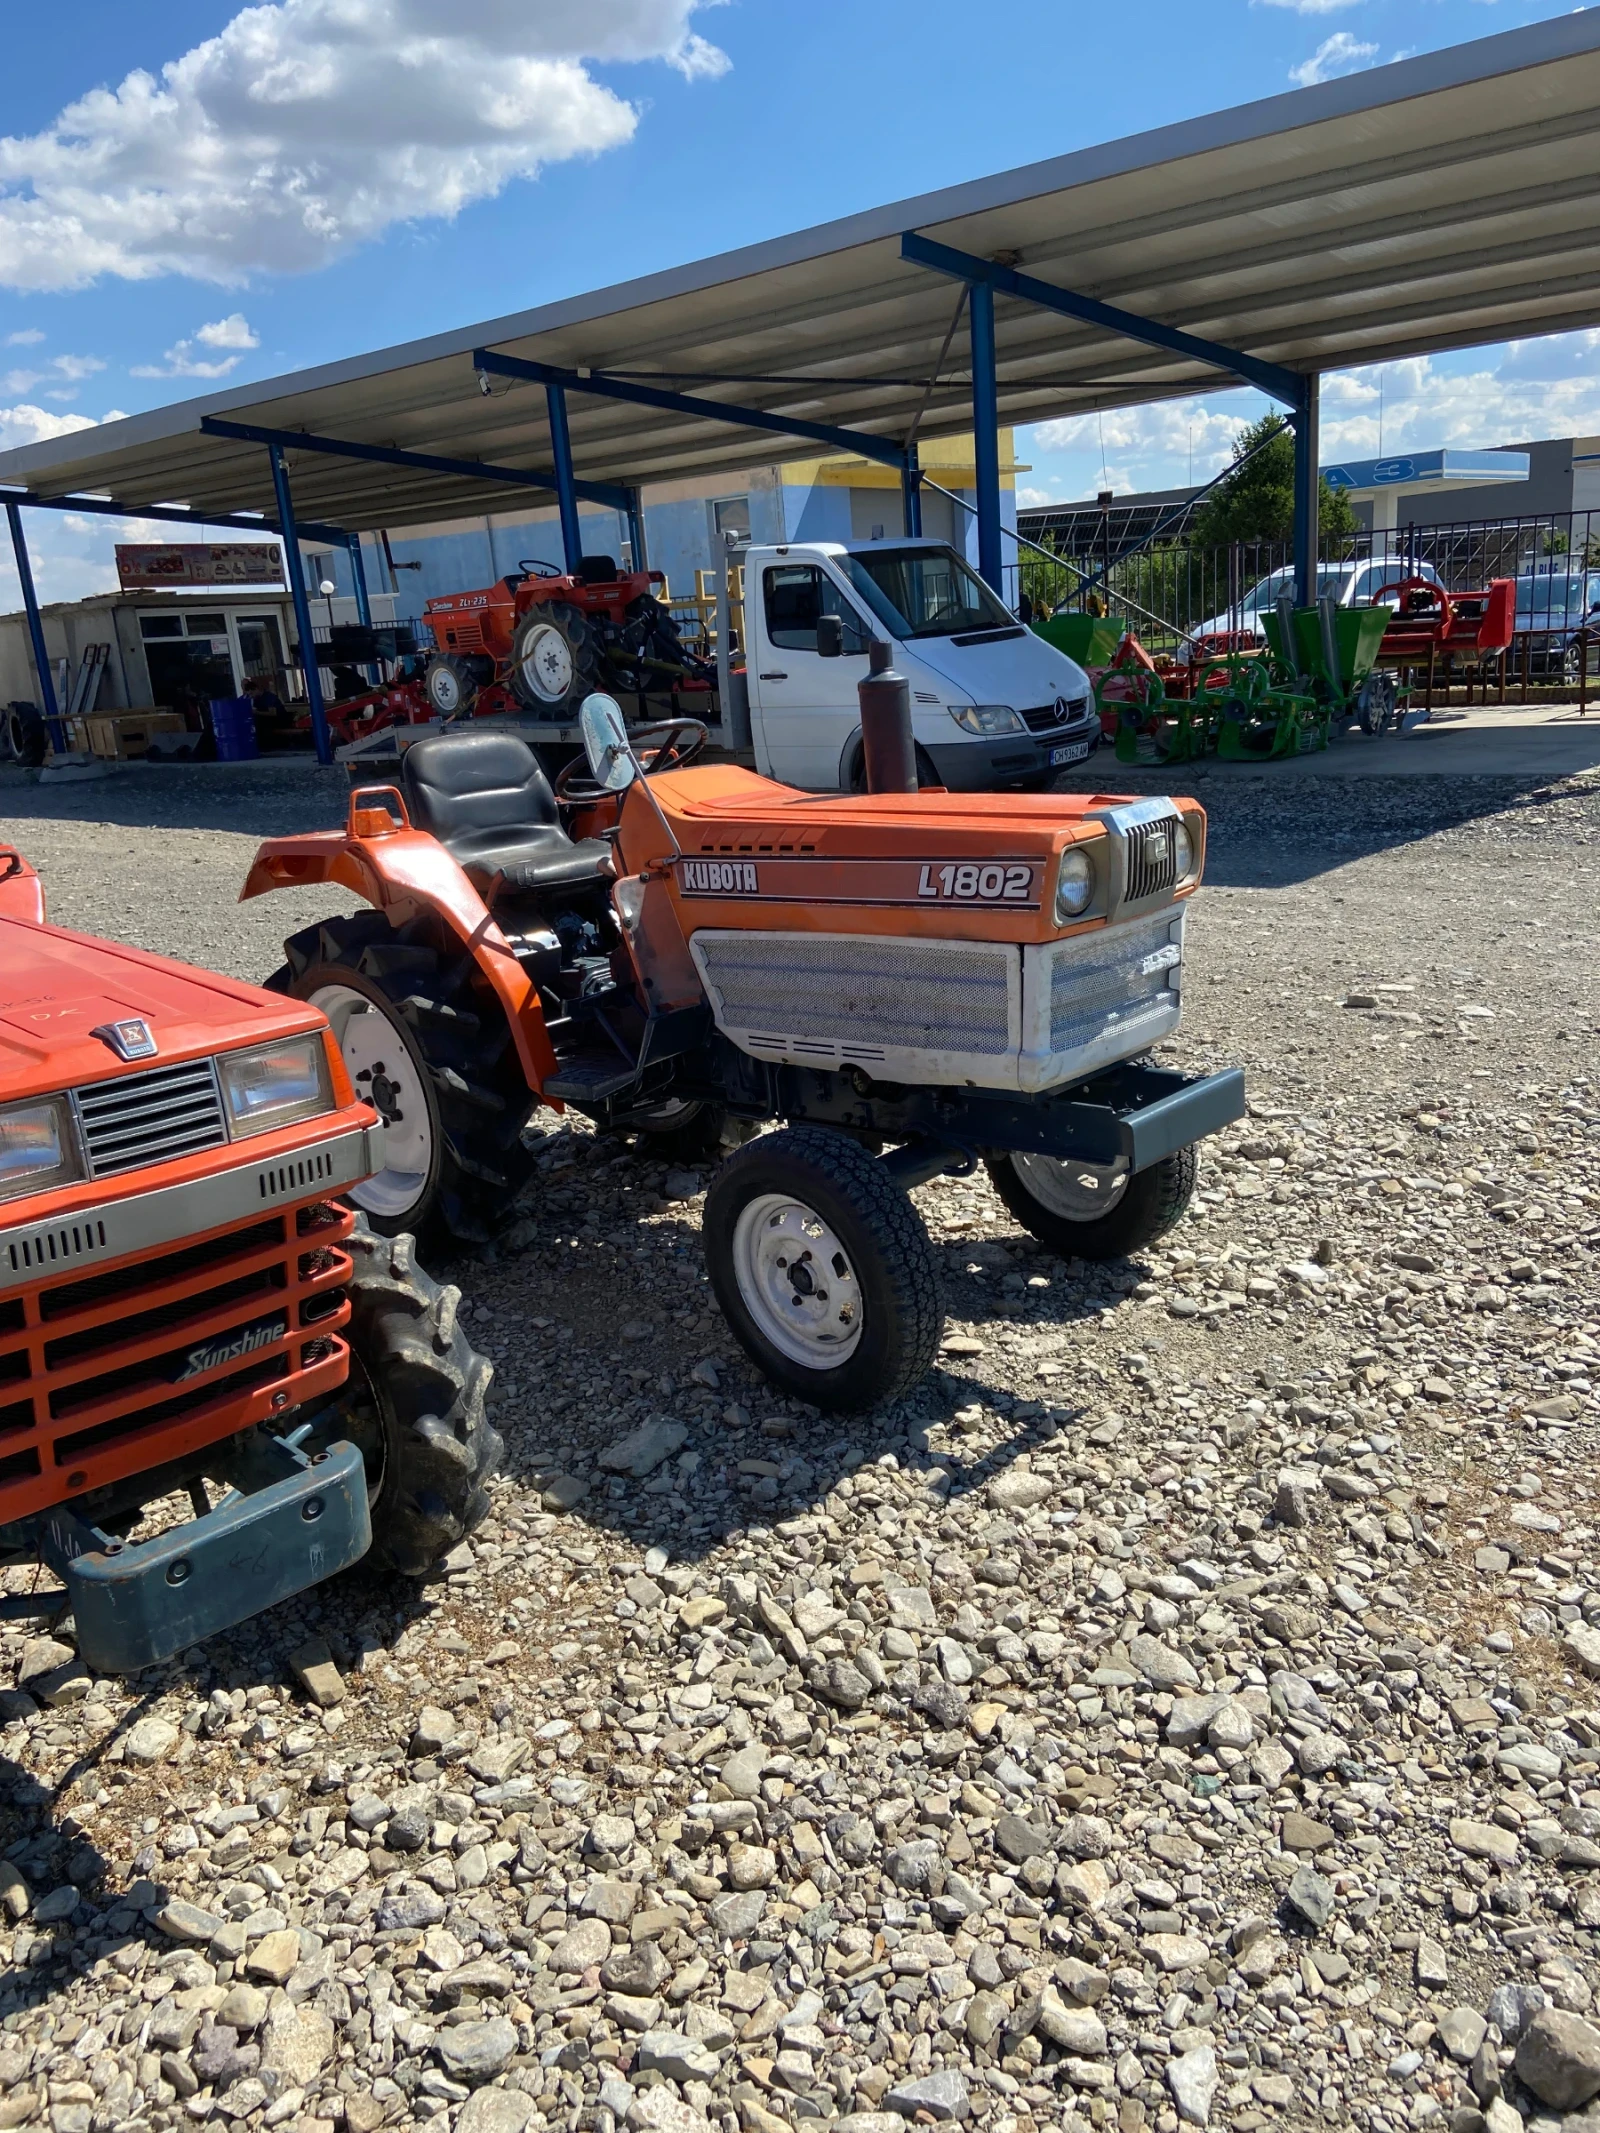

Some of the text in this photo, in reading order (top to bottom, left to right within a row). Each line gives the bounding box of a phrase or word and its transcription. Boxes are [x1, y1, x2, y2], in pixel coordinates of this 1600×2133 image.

[1539, 563, 1558, 574] BLE
[1064, 746, 1079, 760] 9362
[683, 862, 758, 891] KUBOTA
[917, 865, 1031, 898] L1802
[174, 1322, 285, 1384] Sunshine
